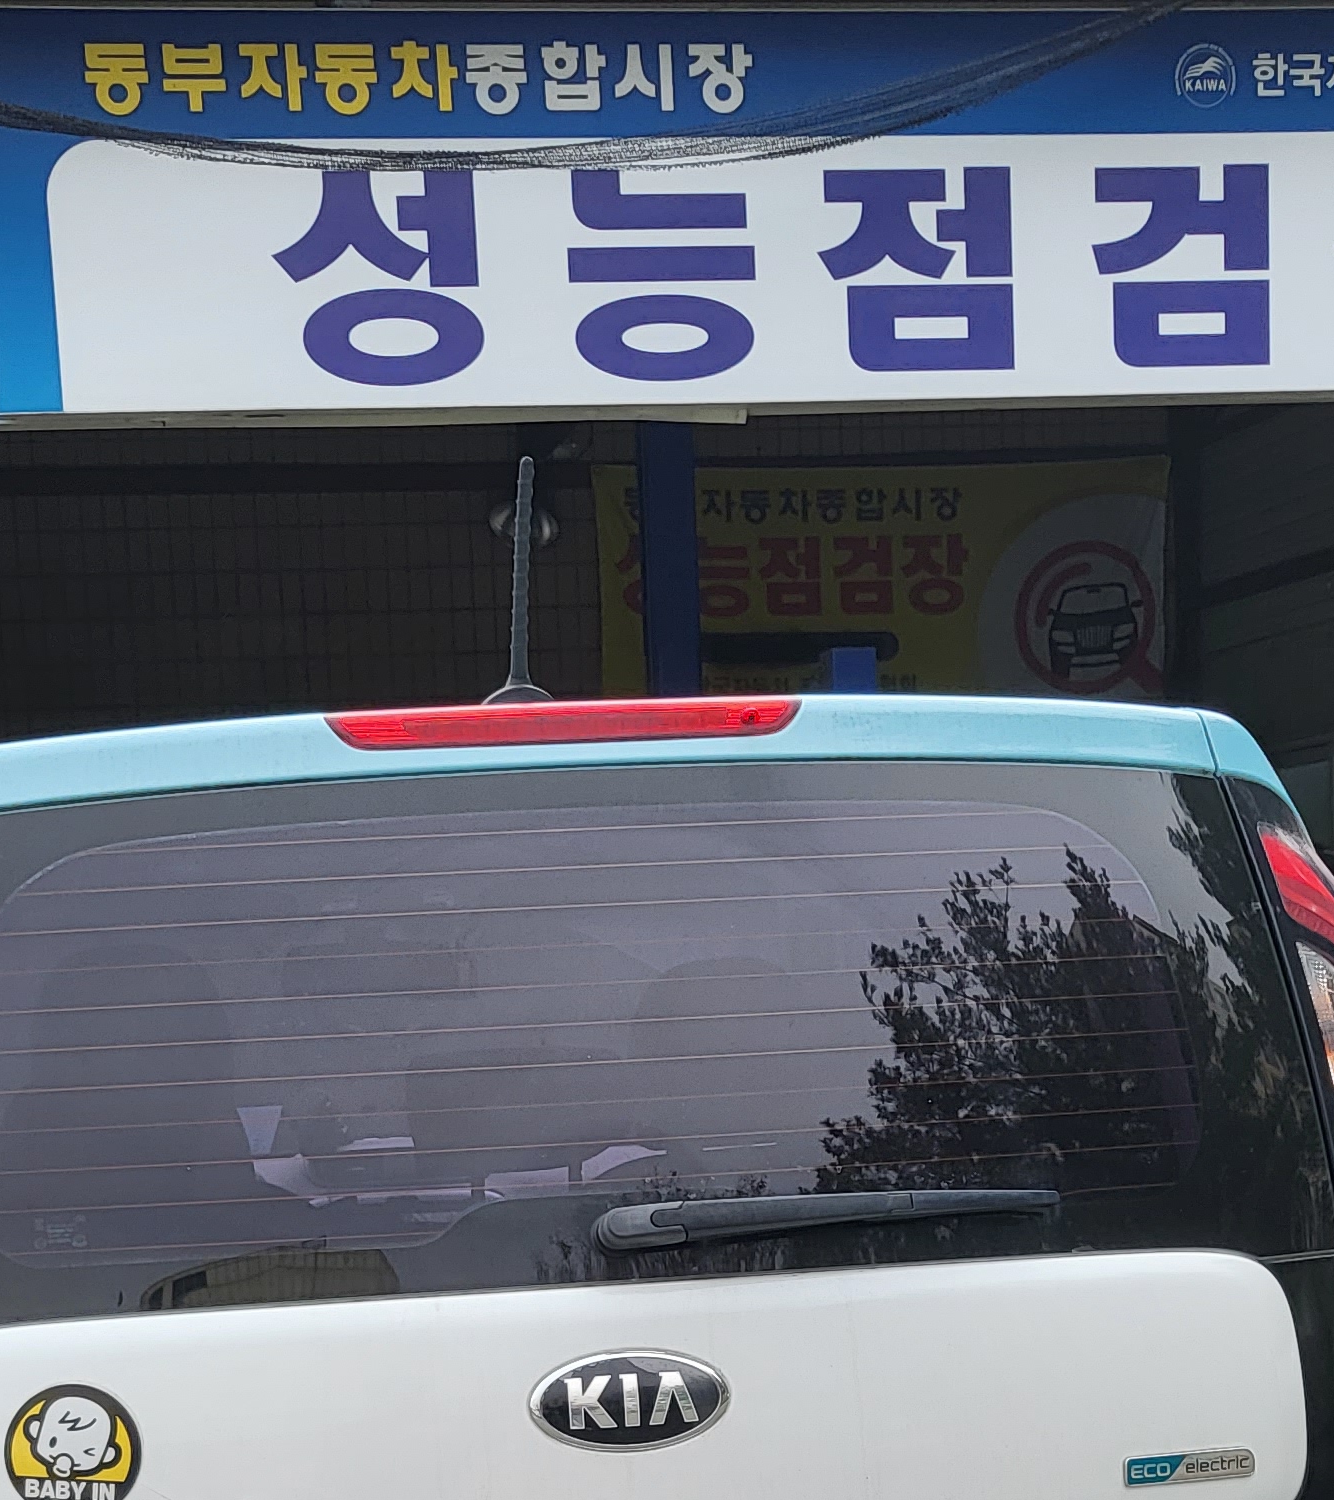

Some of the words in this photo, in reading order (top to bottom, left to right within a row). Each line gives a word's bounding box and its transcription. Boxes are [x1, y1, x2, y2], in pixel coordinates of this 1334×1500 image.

[82, 40, 753, 116] 동부자동차종합시장
[1184, 77, 1227, 93] KAIWA
[623, 486, 964, 525] 자동차종합시장
[563, 1370, 700, 1430] KIA
[1130, 1462, 1171, 1479] ECO
[1185, 1455, 1250, 1474] electric
[24, 1478, 87, 1500] BABY
